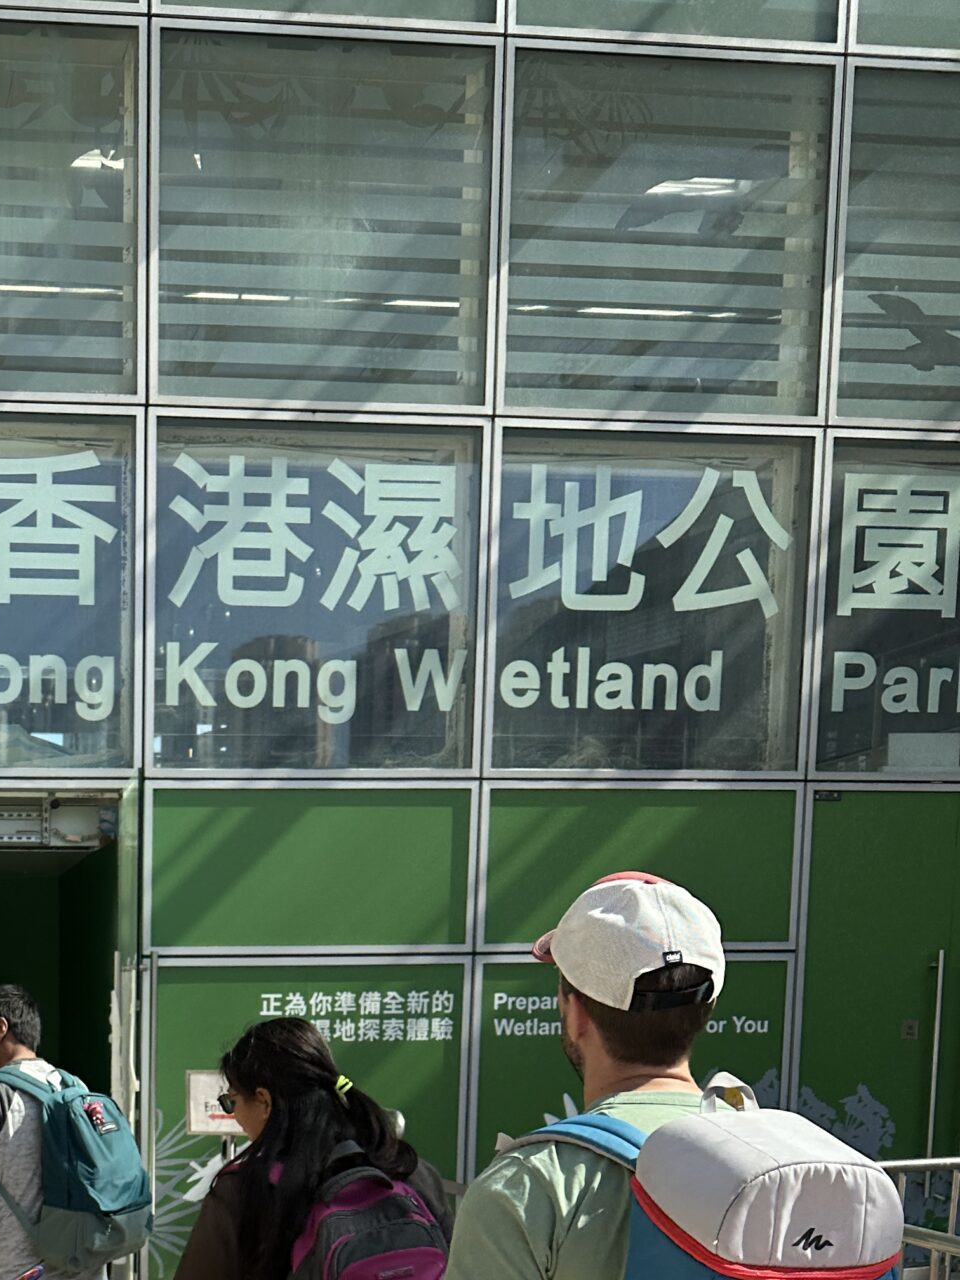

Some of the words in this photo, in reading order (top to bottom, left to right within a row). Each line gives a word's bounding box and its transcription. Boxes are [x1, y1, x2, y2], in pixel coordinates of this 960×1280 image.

[165, 641, 358, 725] Kong
[394, 646, 724, 712] Wetland
[830, 650, 960, 714] Par
[259, 989, 455, 1017] 正為你準備全新的
[493, 993, 558, 1013] Prepar
[493, 1018, 562, 1036] Wetlan
[704, 1018, 727, 1034] or
[732, 1016, 769, 1034] You
